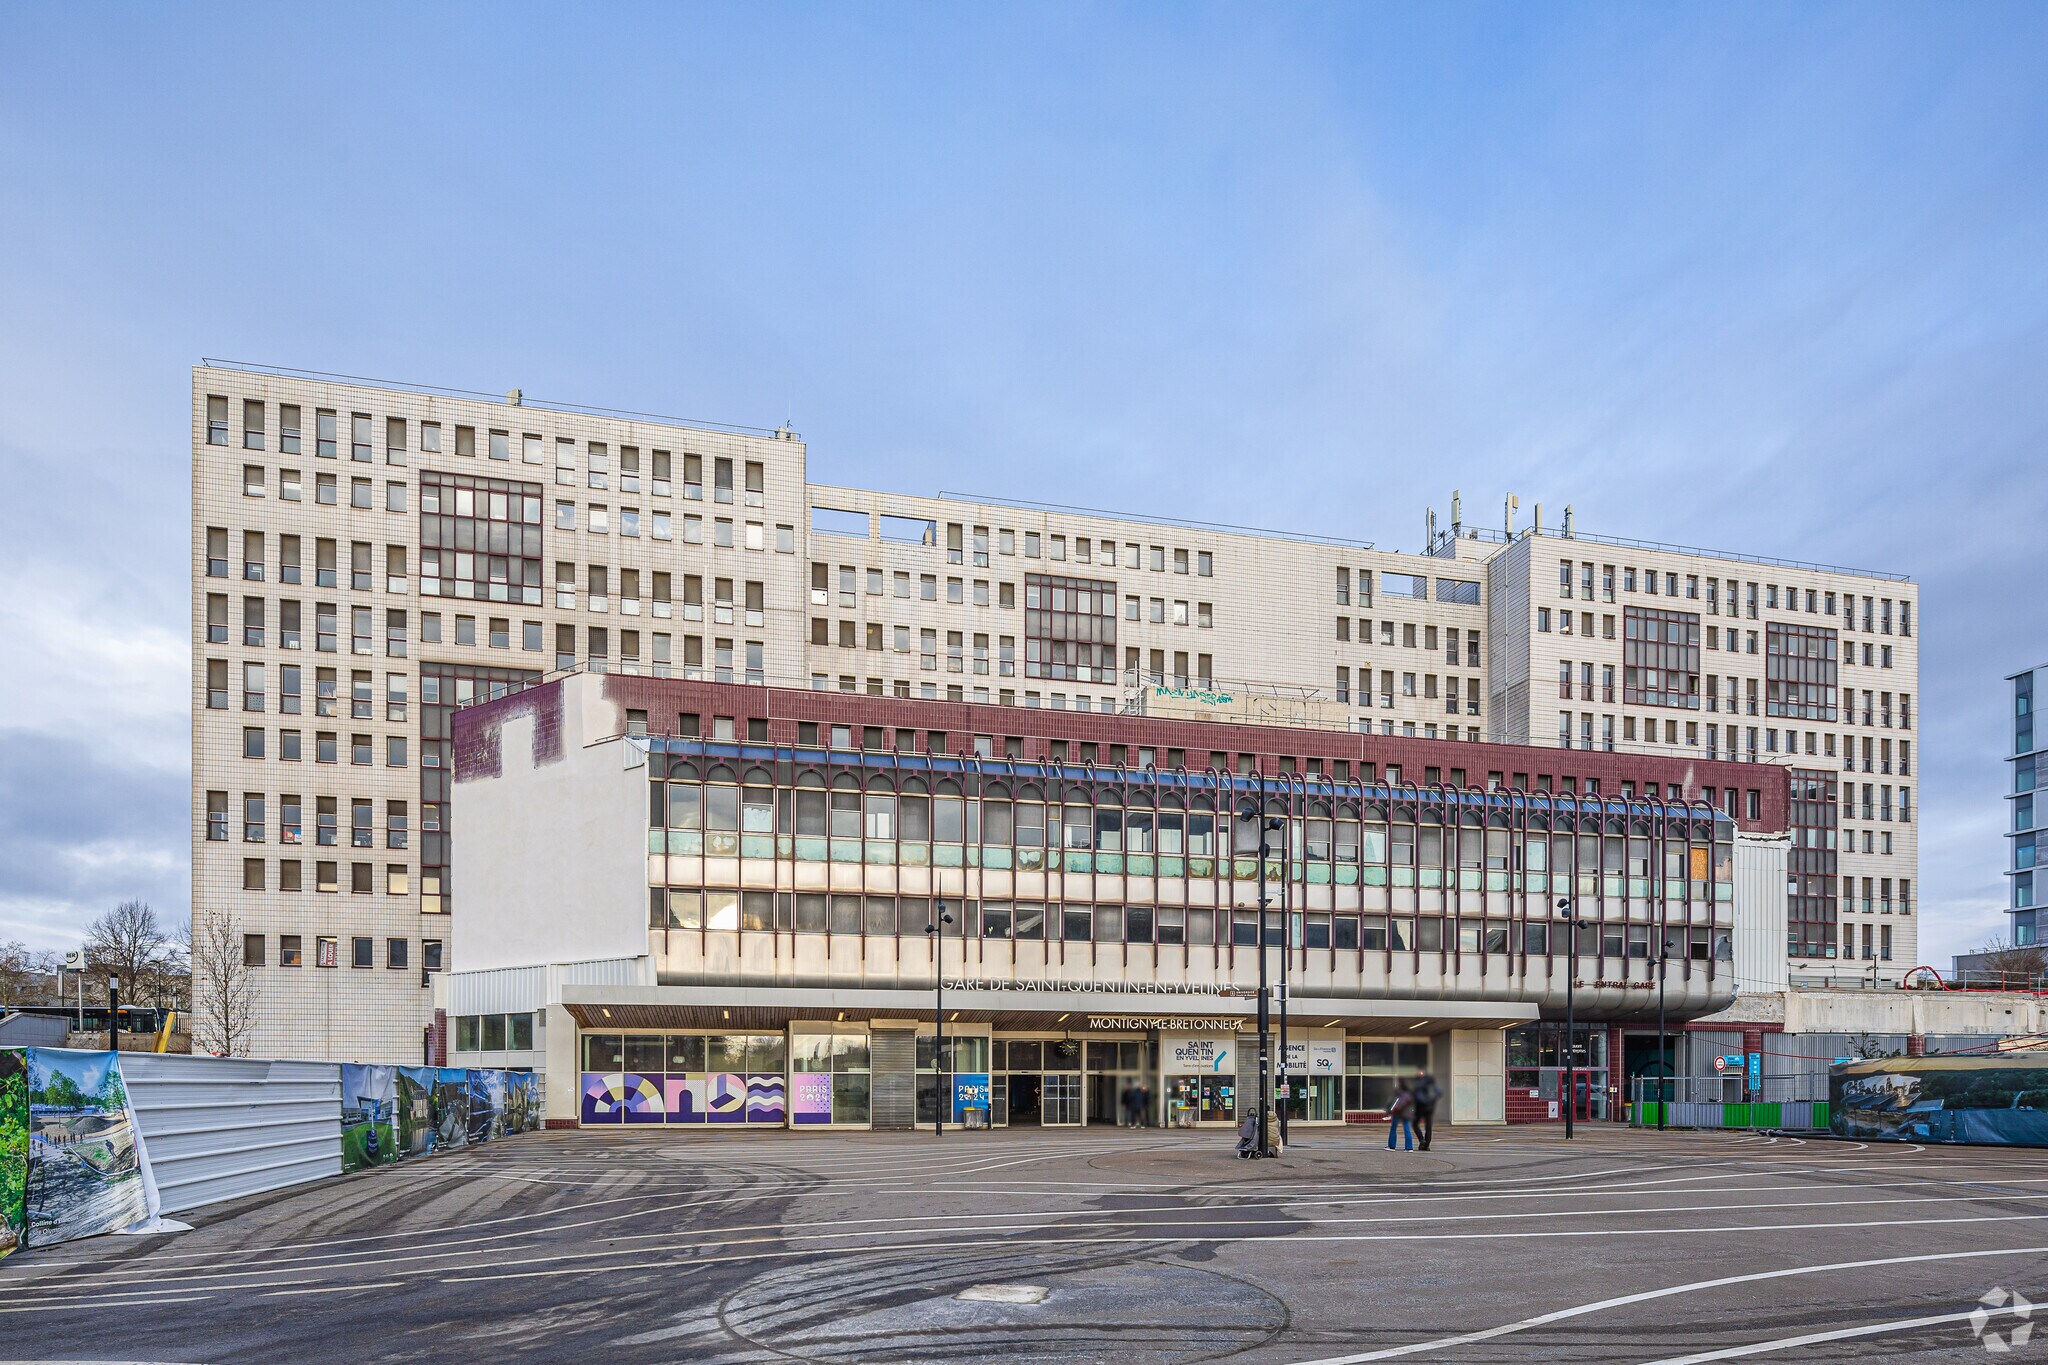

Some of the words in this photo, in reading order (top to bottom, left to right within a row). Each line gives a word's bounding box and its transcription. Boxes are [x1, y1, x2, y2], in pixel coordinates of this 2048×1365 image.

[940, 976, 984, 991] GARE
[990, 977, 1010, 991] DE
[1015, 977, 1240, 995] SAINT-QUENTIN-EN-YVELINES
[1632, 982, 1656, 990] GARE
[1089, 1018, 1244, 1030] MONTIGNY-LE-BRETONNEUX
[1187, 1041, 1214, 1049] SAINT
[1175, 1048, 1214, 1056] QUENTIN
[800, 1085, 828, 1093] PARIS
[31, 1219, 53, 1228] Colline
